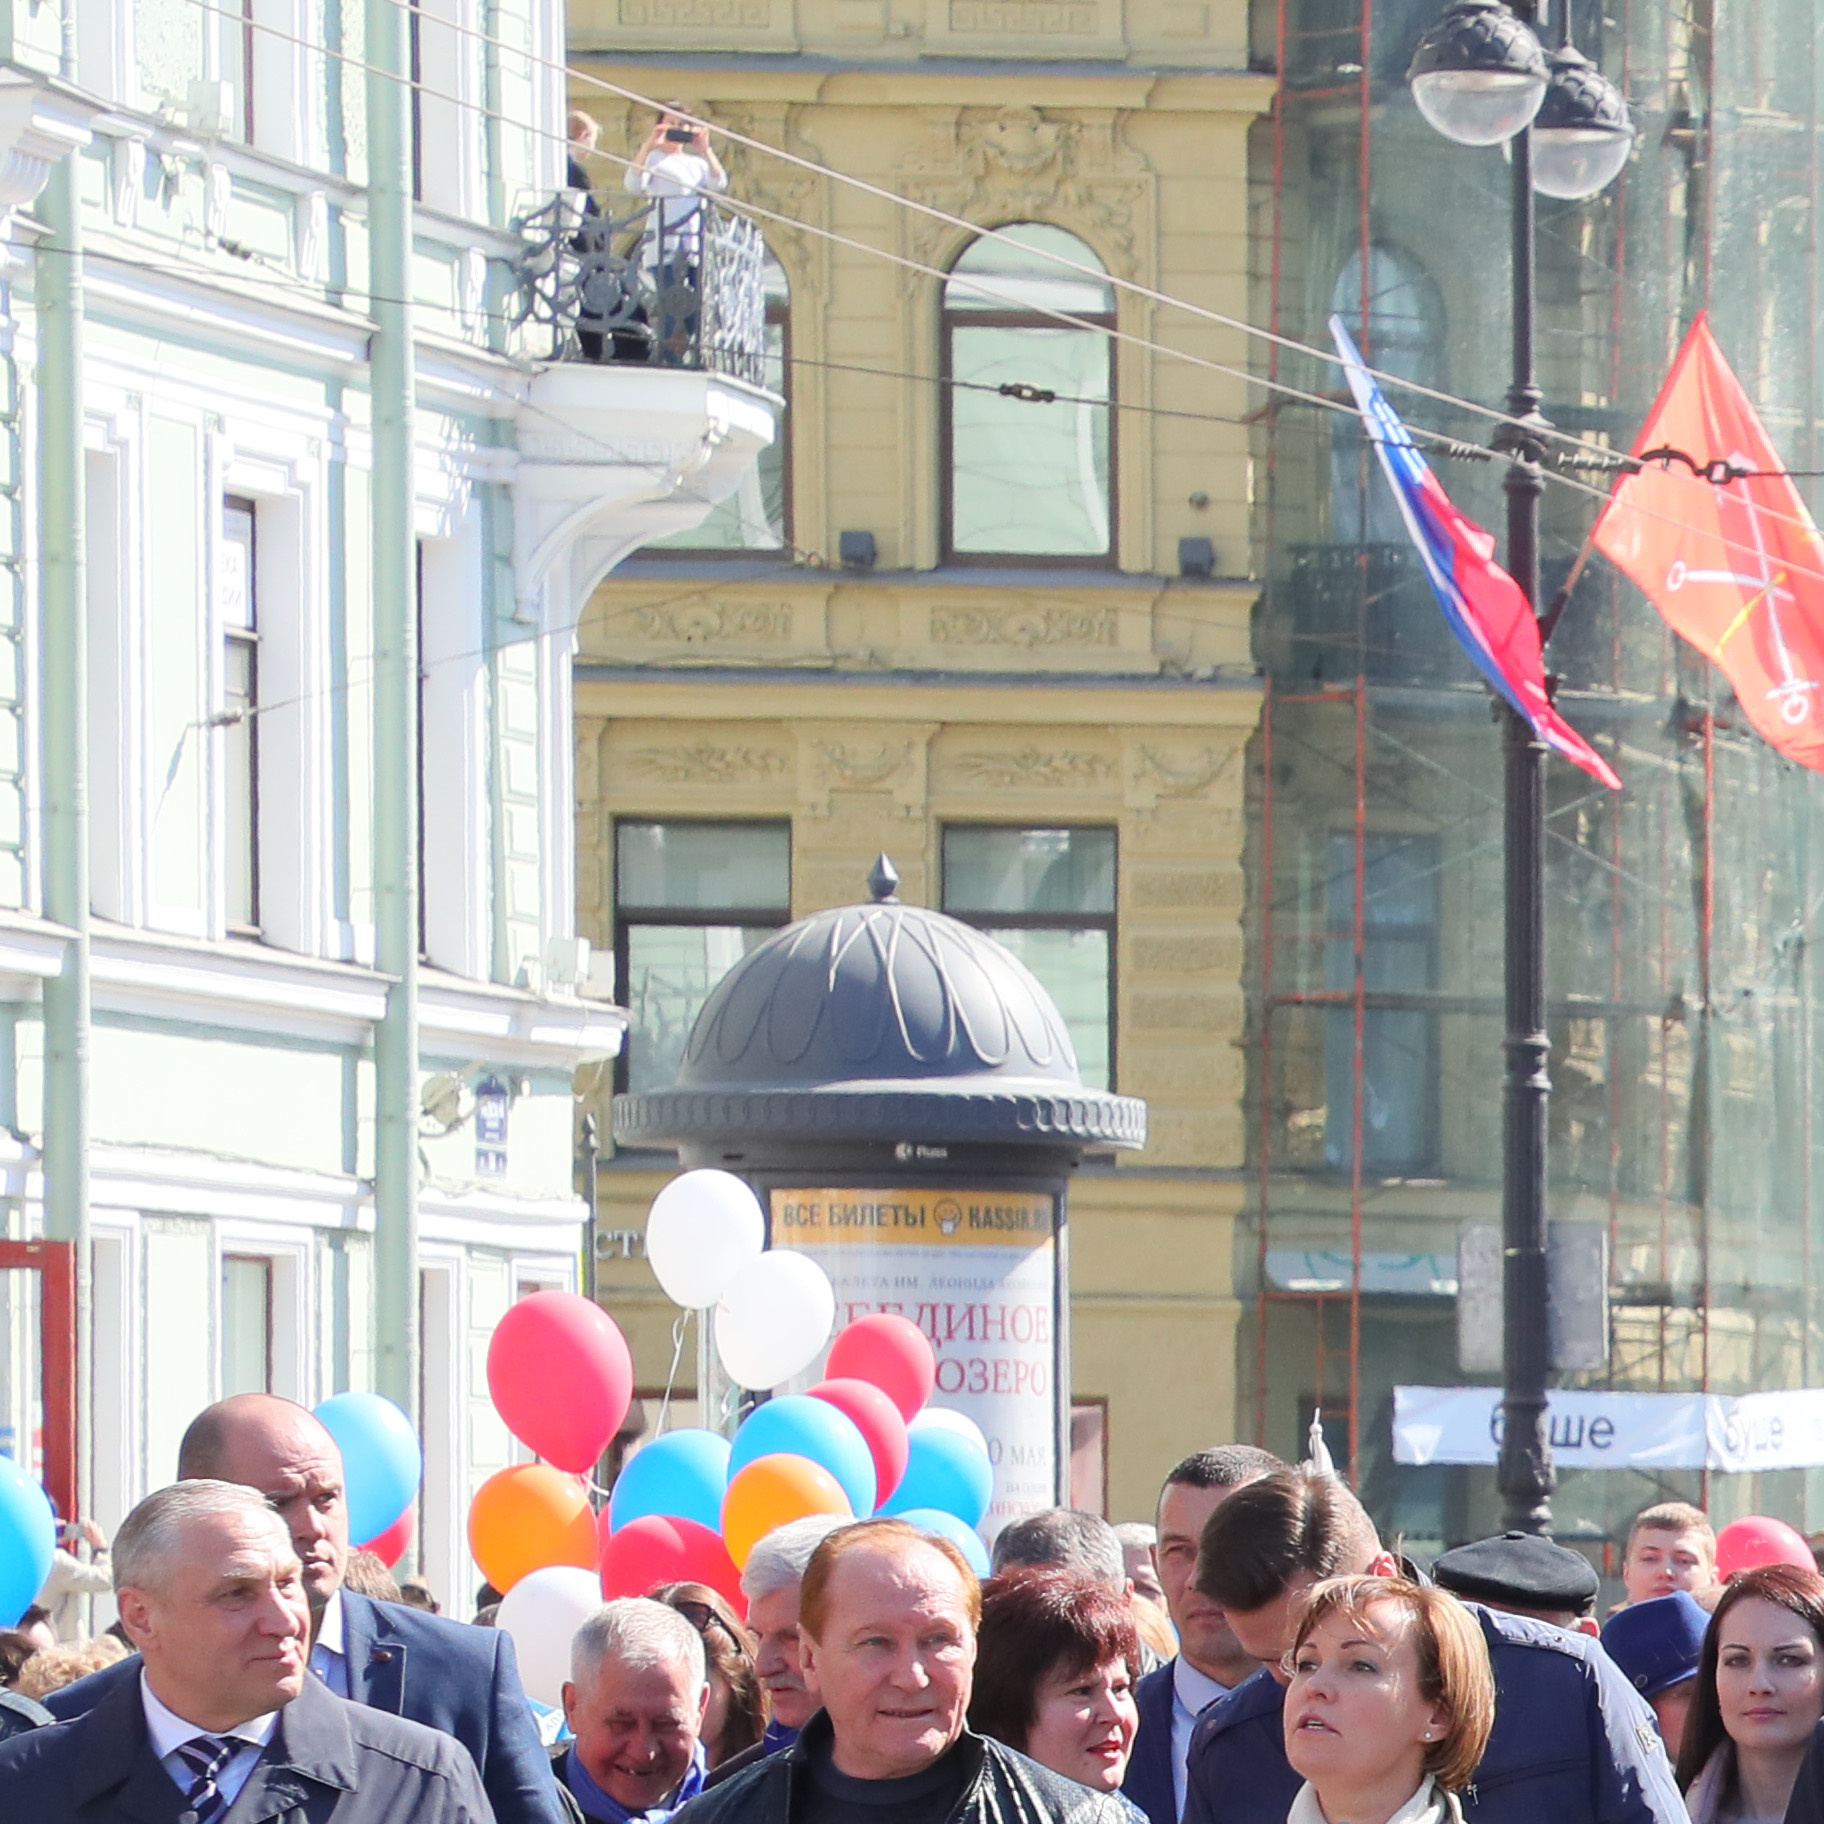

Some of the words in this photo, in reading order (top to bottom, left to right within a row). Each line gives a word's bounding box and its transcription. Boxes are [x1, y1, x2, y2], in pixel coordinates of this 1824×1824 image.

[783, 1204, 821, 1228] ВСЕ
[828, 1204, 926, 1229] БИЛЕТЫ
[936, 1357, 1047, 1396] ОЗЕРО
